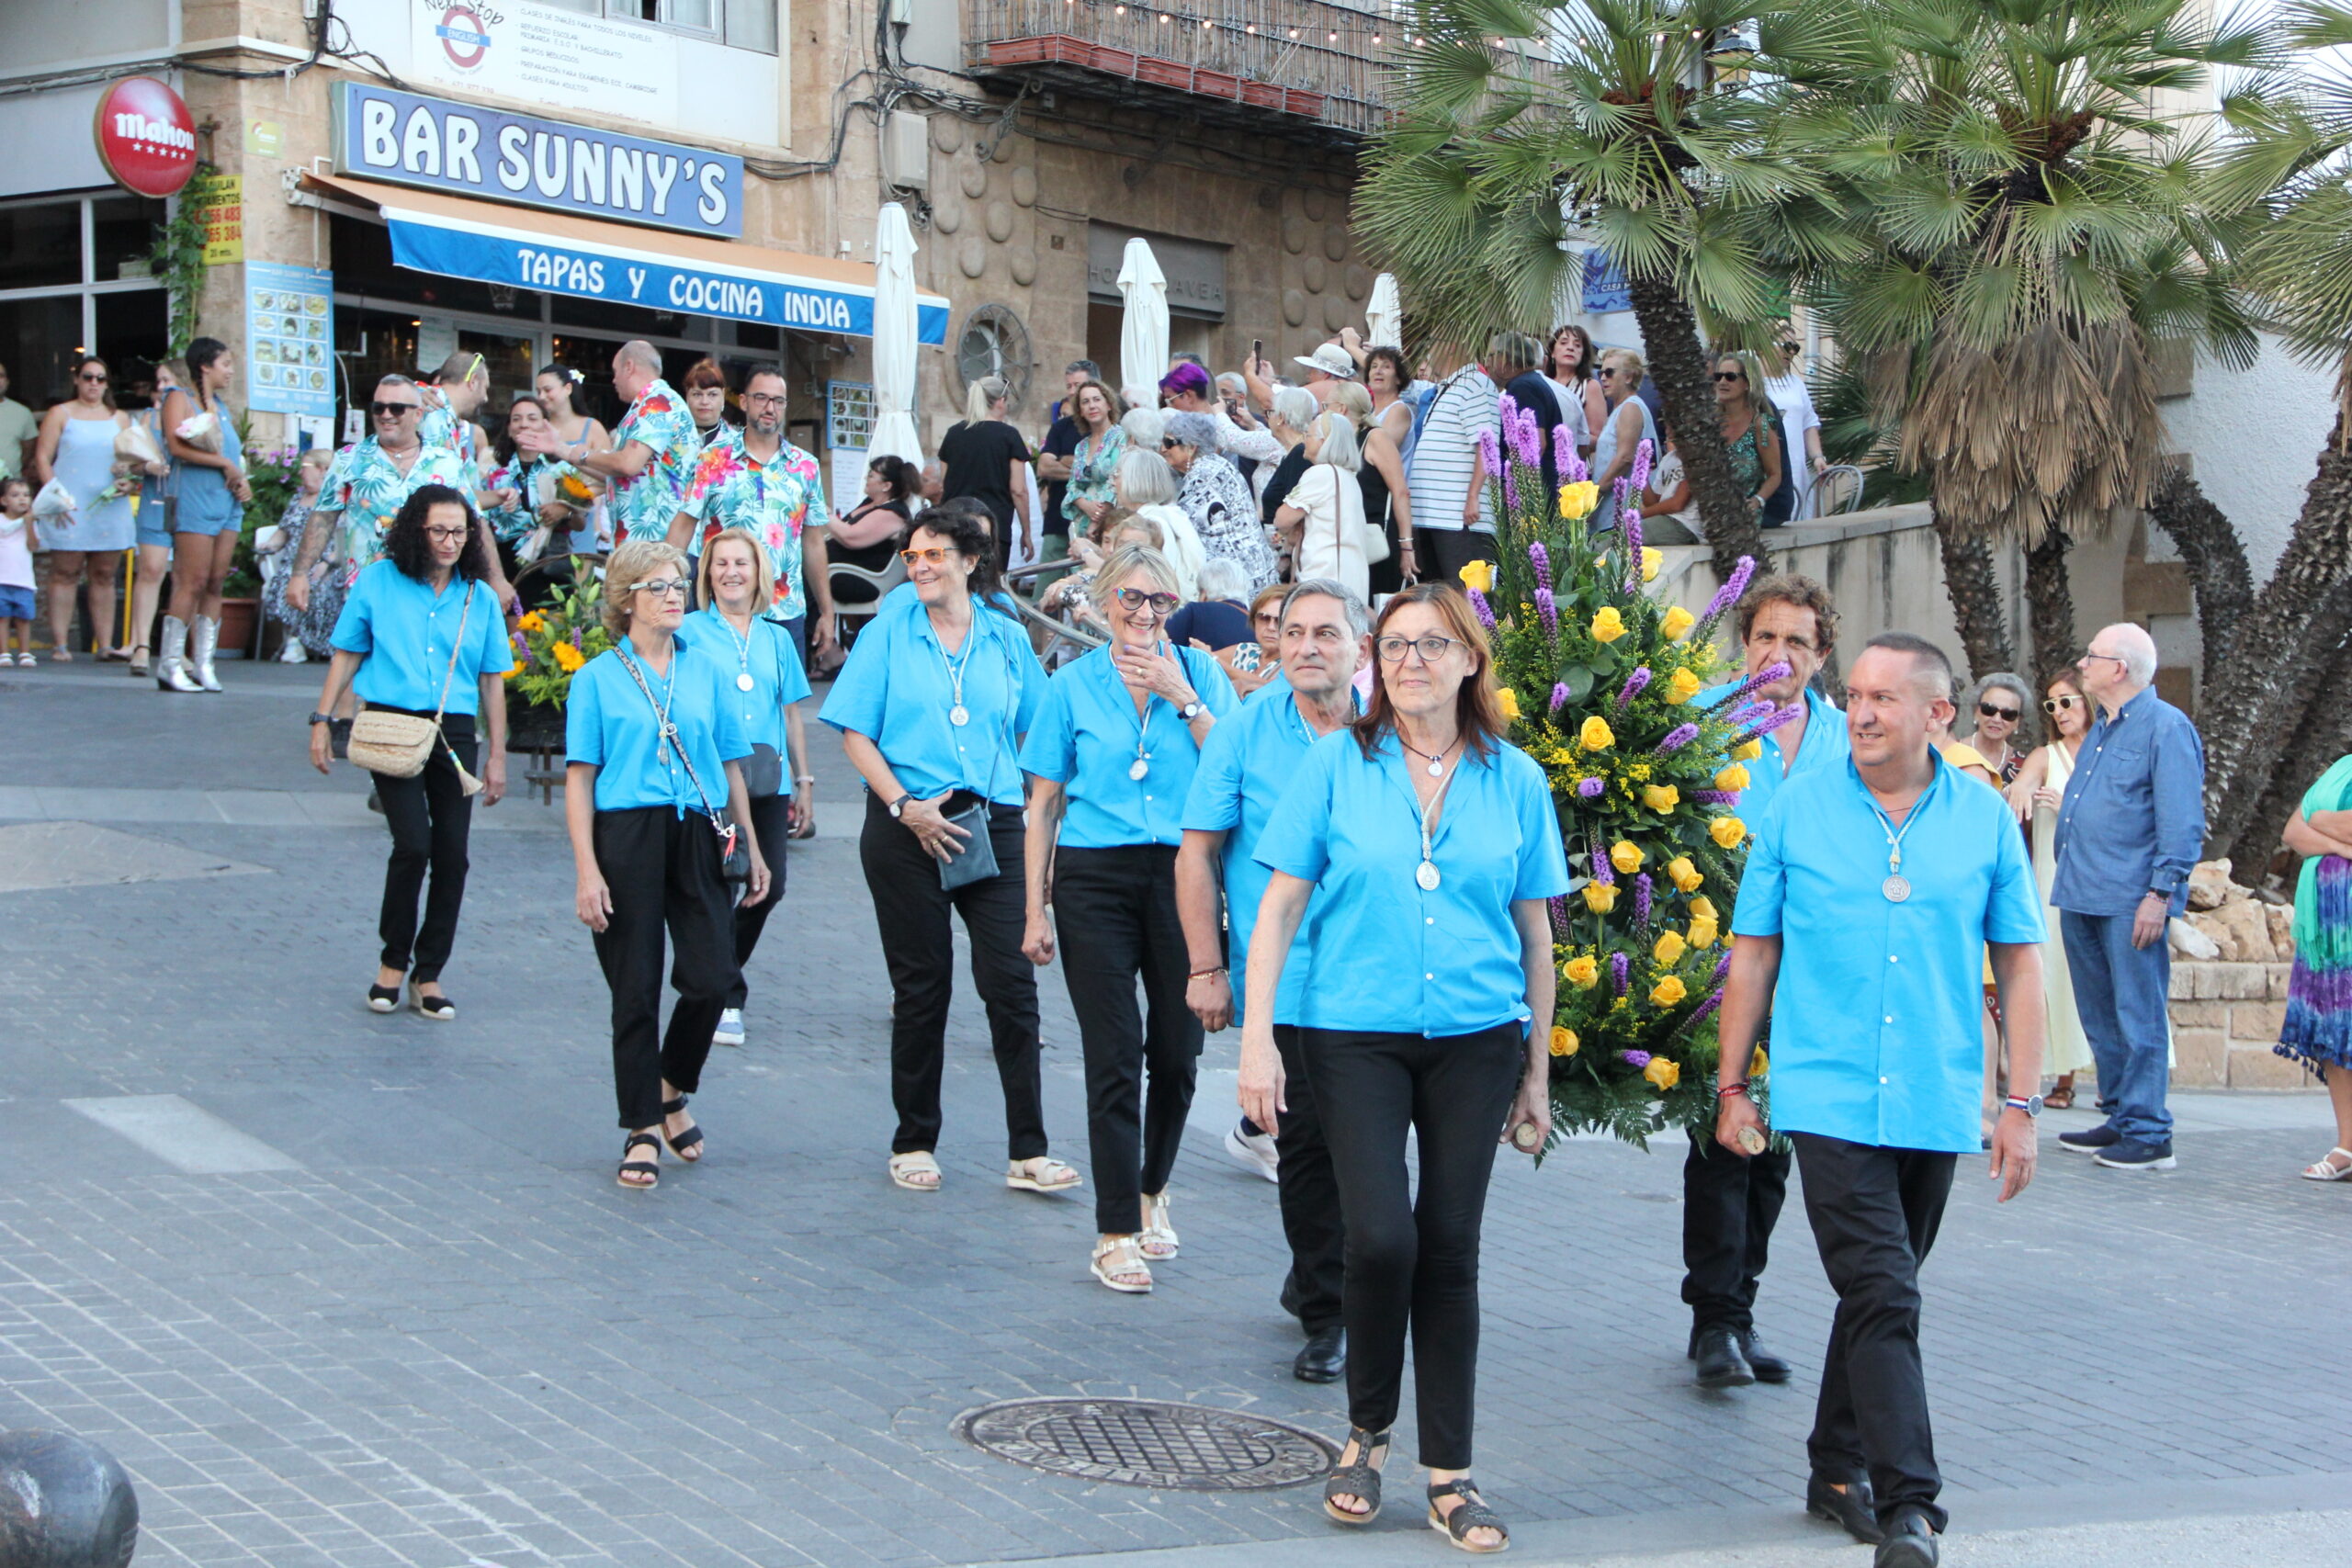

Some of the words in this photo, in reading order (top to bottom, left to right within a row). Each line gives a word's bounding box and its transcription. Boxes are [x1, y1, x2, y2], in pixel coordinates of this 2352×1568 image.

[467, 0, 504, 28] Stop
[114, 113, 195, 151] Mahou
[362, 97, 482, 184] BAR
[518, 249, 606, 293] TAPAS
[628, 267, 646, 299] Y
[669, 274, 763, 317] COCINA
[785, 291, 851, 329] INDIA
[1600, 283, 1621, 292] CASA
